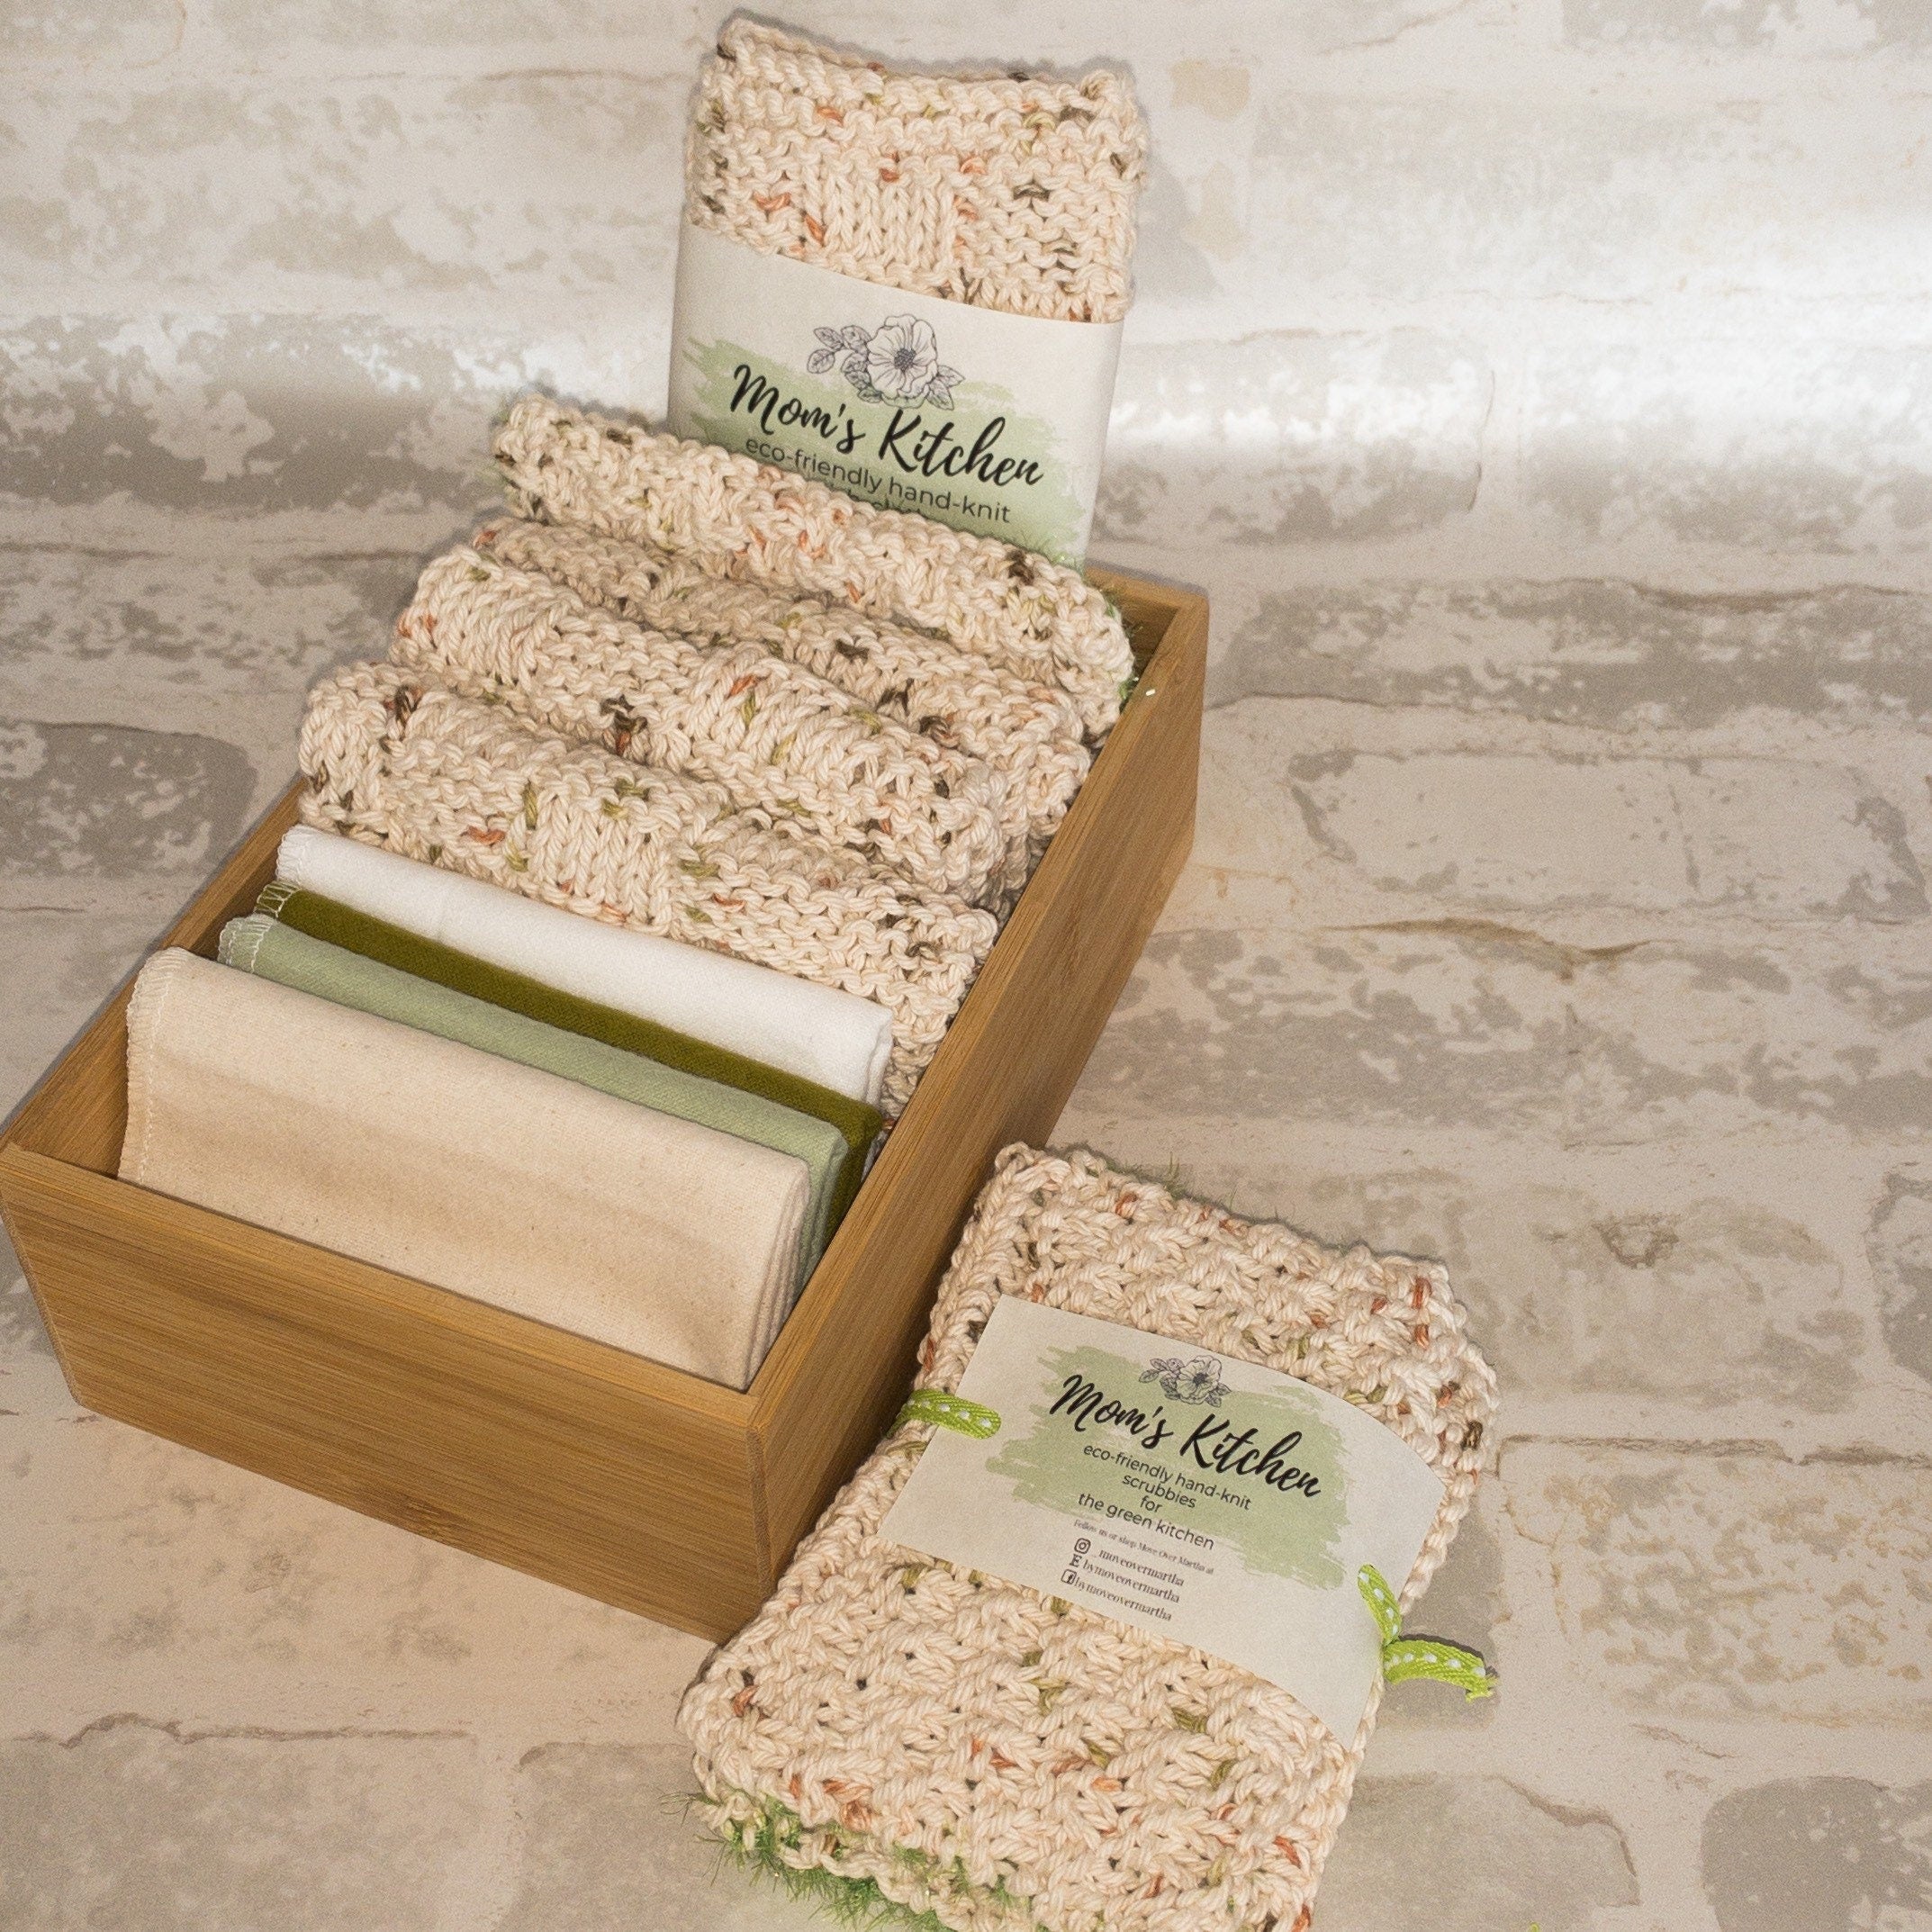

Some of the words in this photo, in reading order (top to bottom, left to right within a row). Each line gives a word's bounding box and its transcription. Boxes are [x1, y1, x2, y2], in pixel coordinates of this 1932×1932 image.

[730, 364, 865, 454] Mom's
[878, 407, 1043, 487] Kitchen
[745, 437, 882, 494] eco-friendly
[889, 474, 1011, 524] hand-knit
[1050, 1374, 1173, 1449] Mom's
[1179, 1413, 1321, 1498] Kitchen
[1084, 1444, 1173, 1484] eco-friendly
[1175, 1470, 1251, 1511] hand-knit
[1123, 1473, 1196, 1509] scrubbies
[1140, 1495, 1162, 1513] for
[1074, 1519, 1097, 1532] Follow
[1098, 1529, 1107, 1537] us
[1108, 1533, 1118, 1541] or
[1119, 1534, 1137, 1548] shop
[1137, 1541, 1158, 1554] Move
[1159, 1550, 1177, 1562] Over
[1178, 1557, 1205, 1572] Martha
[1078, 1493, 1105, 1511] the
[1106, 1504, 1152, 1529] green
[1156, 1519, 1214, 1550] kitchen
[1074, 1576, 1172, 1621] bymoveovermartha
[1083, 1559, 1180, 1603] bymoveovermartha
